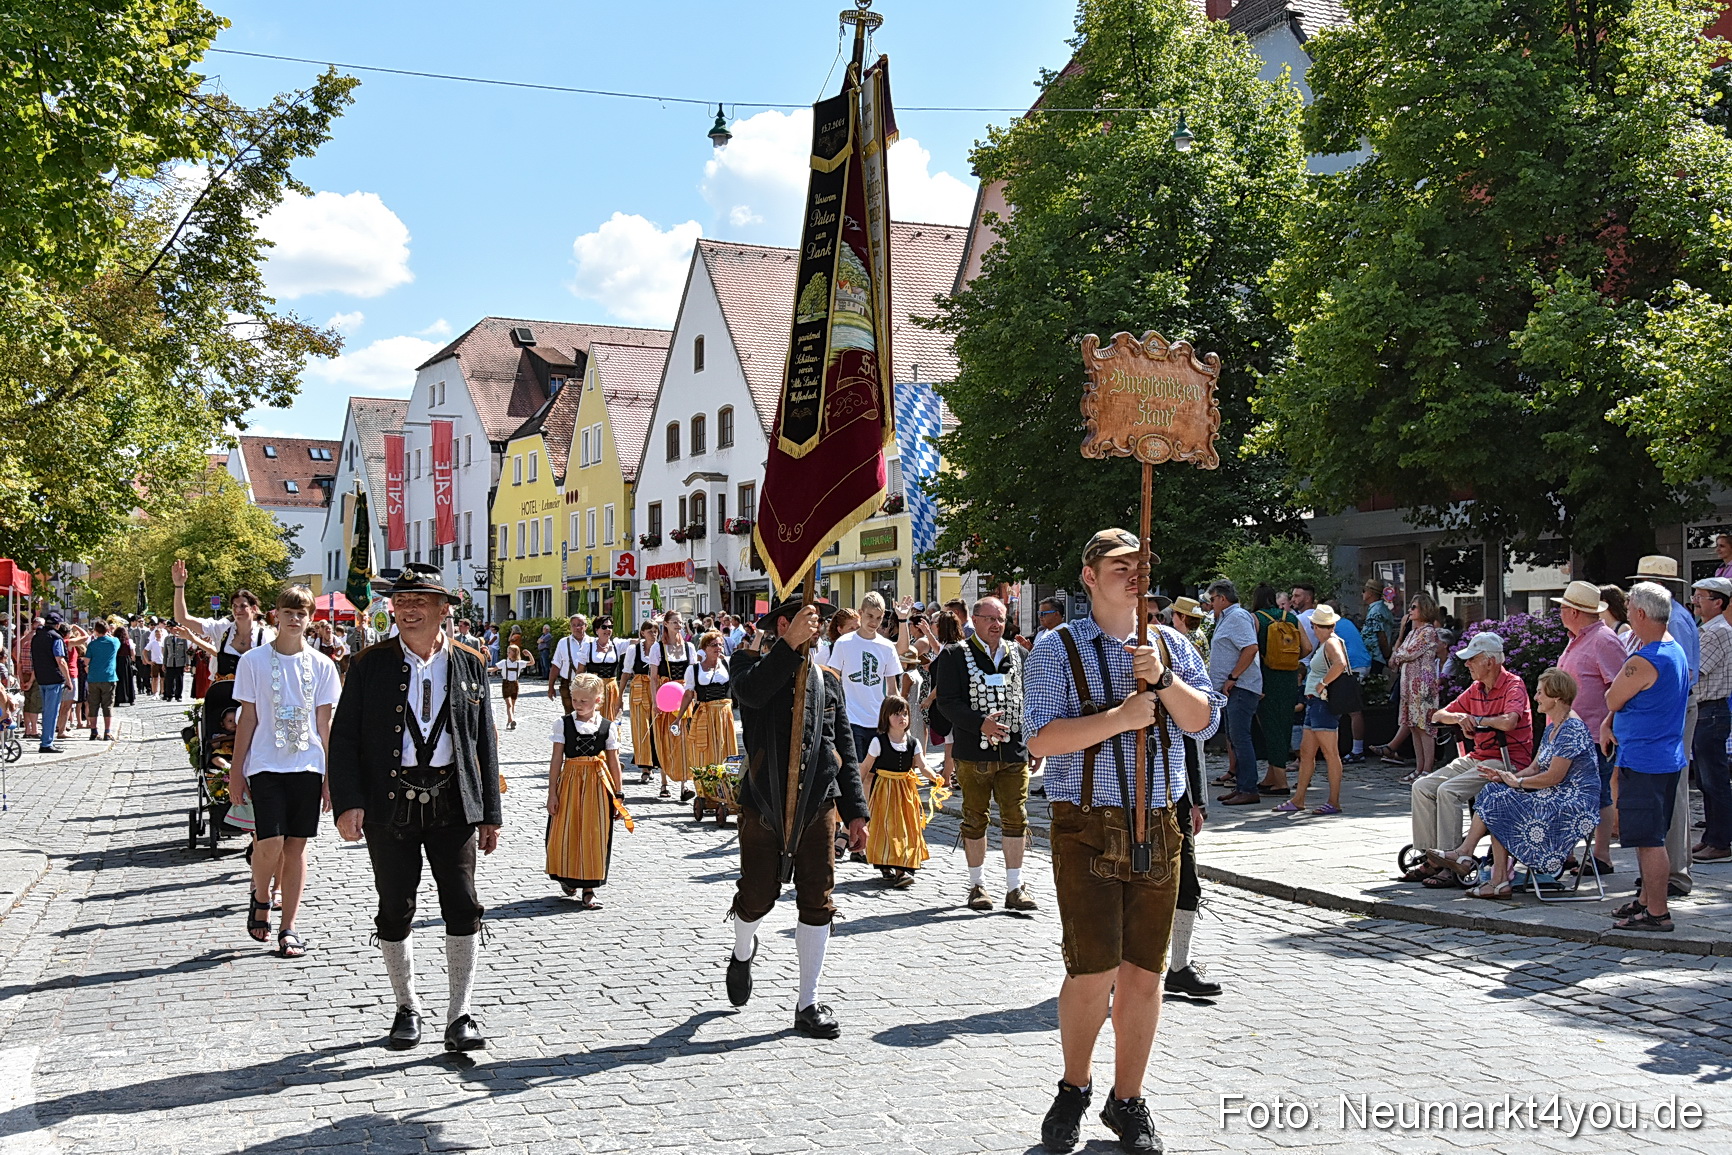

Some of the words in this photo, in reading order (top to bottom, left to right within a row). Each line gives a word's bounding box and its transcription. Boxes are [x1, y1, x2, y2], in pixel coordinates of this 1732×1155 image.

[810, 209, 835, 227] Paten
[806, 238, 832, 260] Dank
[1133, 401, 1177, 433] Stauf
[388, 472, 403, 515] SALE
[521, 500, 538, 516] HOTEL
[519, 573, 542, 584] Restaurant
